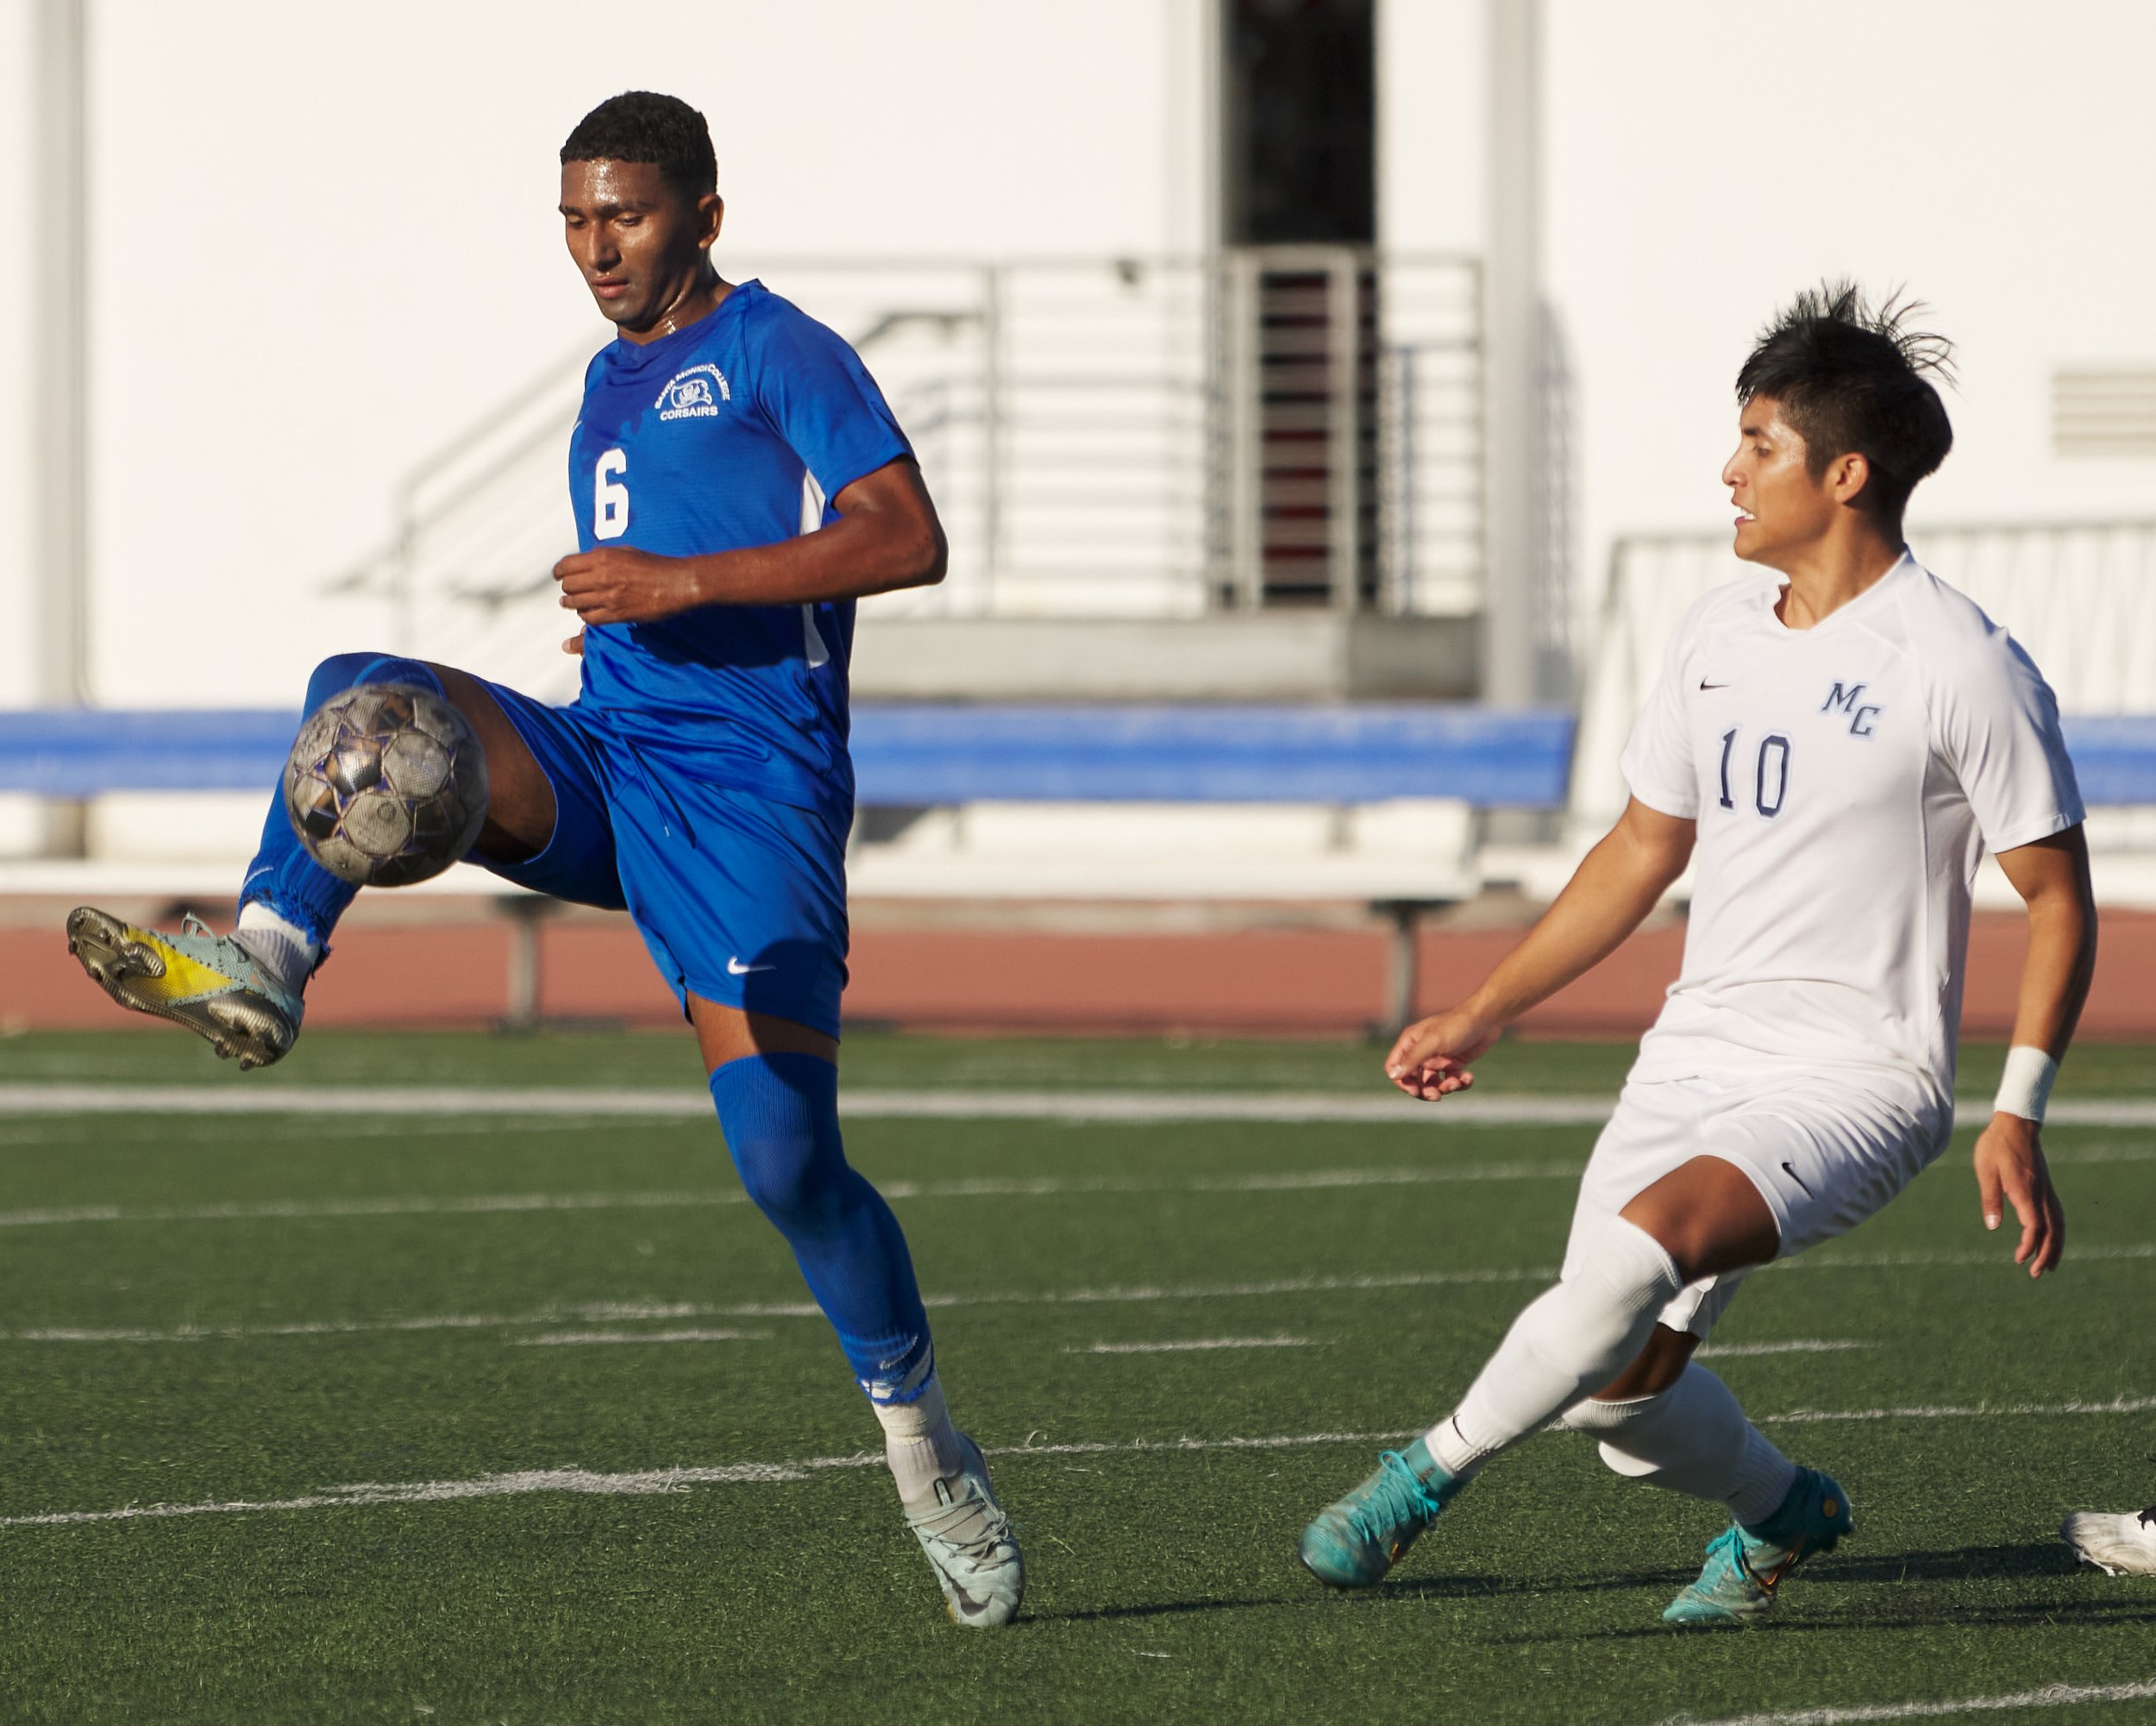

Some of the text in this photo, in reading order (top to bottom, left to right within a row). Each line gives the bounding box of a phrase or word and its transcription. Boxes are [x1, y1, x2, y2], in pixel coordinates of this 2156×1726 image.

[655, 379, 676, 410] SANTA
[707, 363, 730, 401] COLLEGE
[660, 405, 718, 421] CORSAIRS
[594, 448, 630, 541] 6
[1719, 726, 1792, 819] 10
